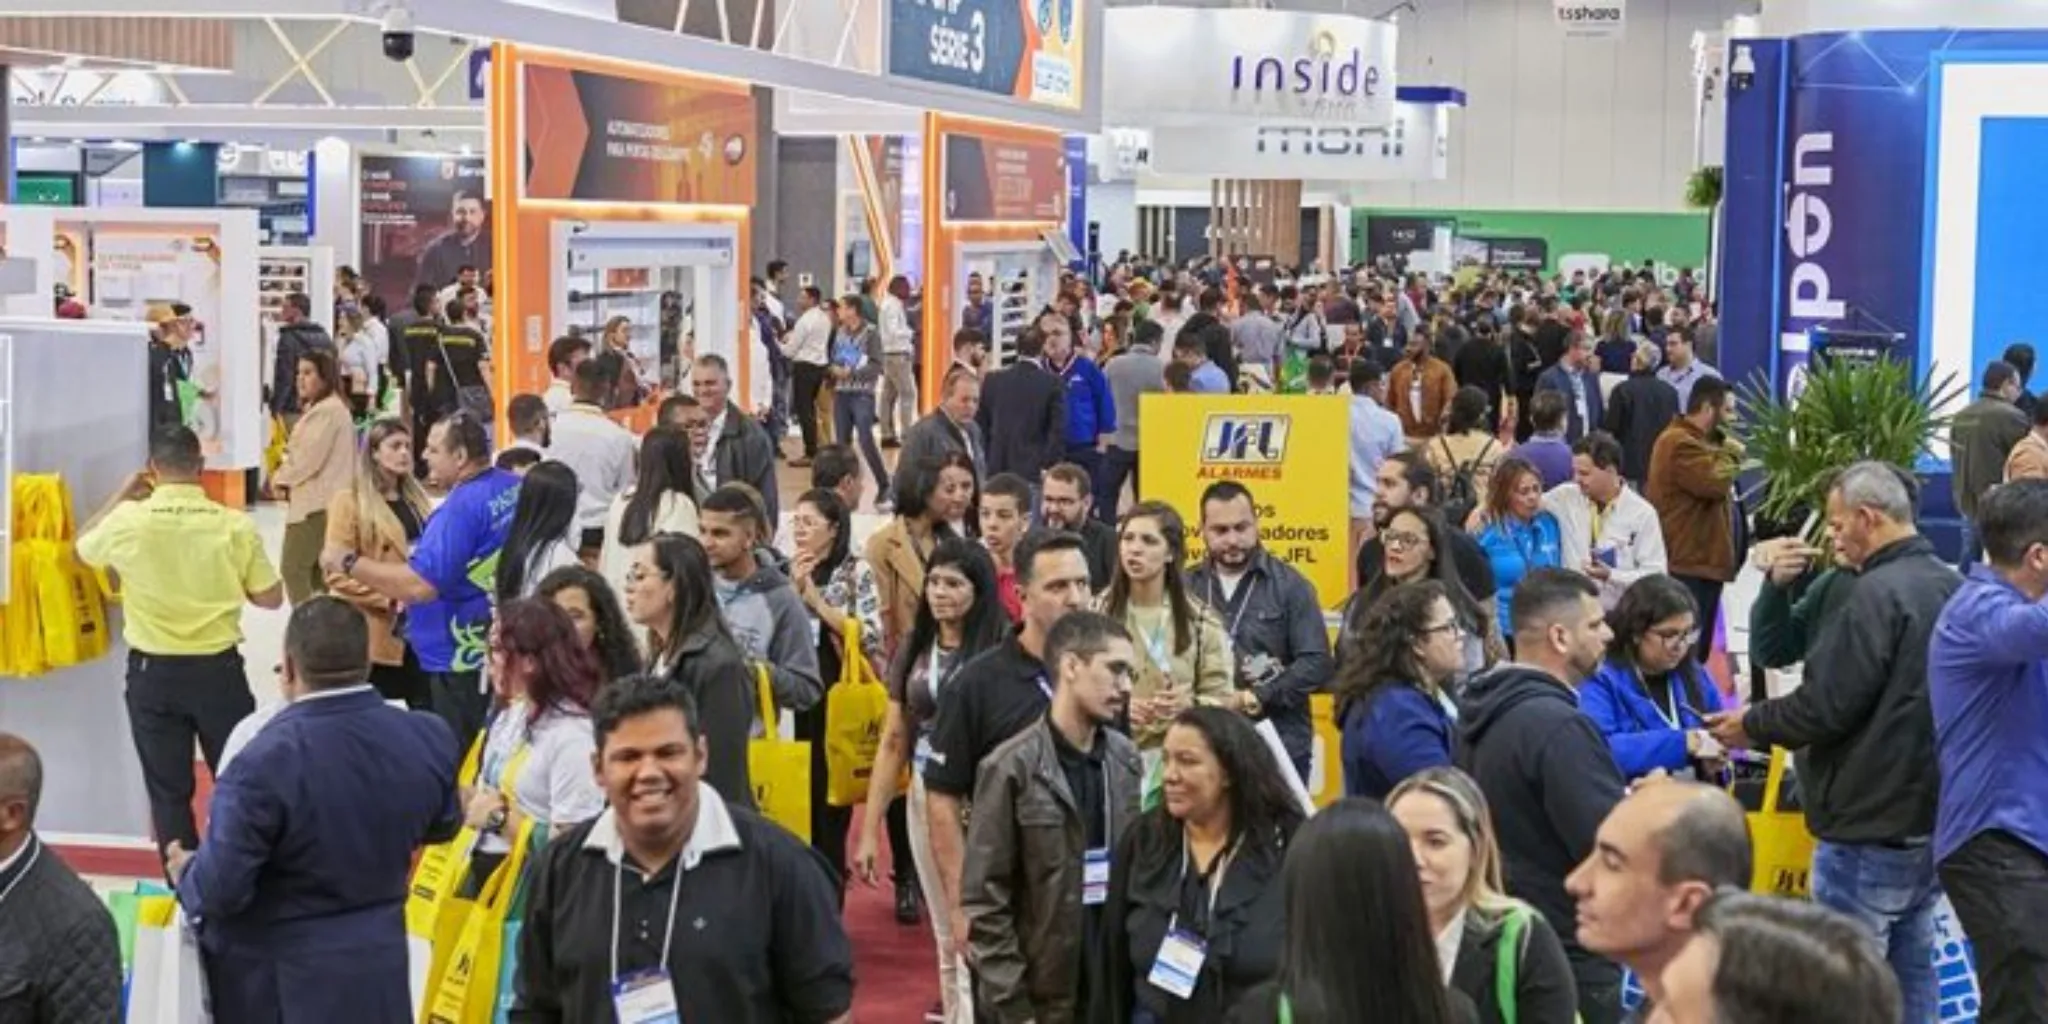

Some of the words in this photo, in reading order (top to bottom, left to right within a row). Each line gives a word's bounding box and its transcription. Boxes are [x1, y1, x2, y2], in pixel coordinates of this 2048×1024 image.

[929, 16, 969, 70] SÉRIE
[970, 9, 985, 74] 3
[1233, 47, 1379, 96] inside
[1208, 421, 1279, 460] JFL
[1198, 466, 1282, 480] ALARMES
[1283, 548, 1317, 564] JFL
